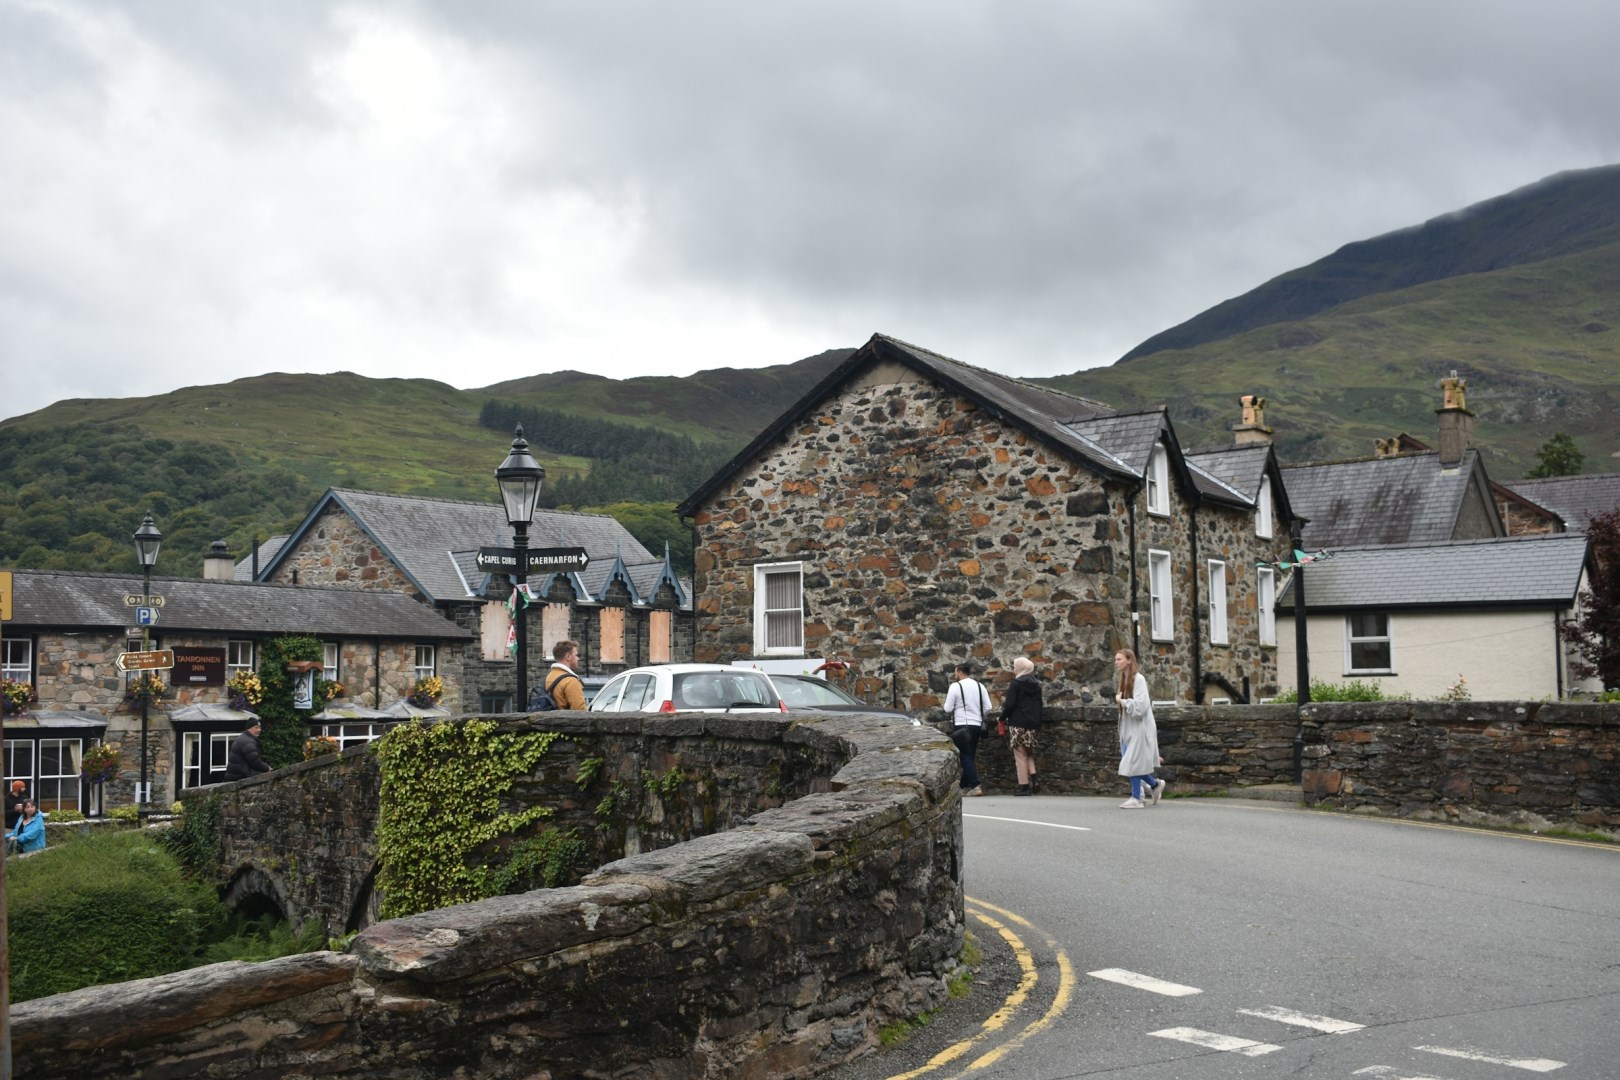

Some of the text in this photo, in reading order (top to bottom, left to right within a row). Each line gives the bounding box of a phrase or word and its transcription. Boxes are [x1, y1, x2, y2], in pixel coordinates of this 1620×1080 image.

[484, 555, 517, 565] CAPEL CURIG
[529, 555, 578, 565] CAERNARFON
[140, 609, 150, 623] P
[176, 655, 221, 663] TANRONNEN
